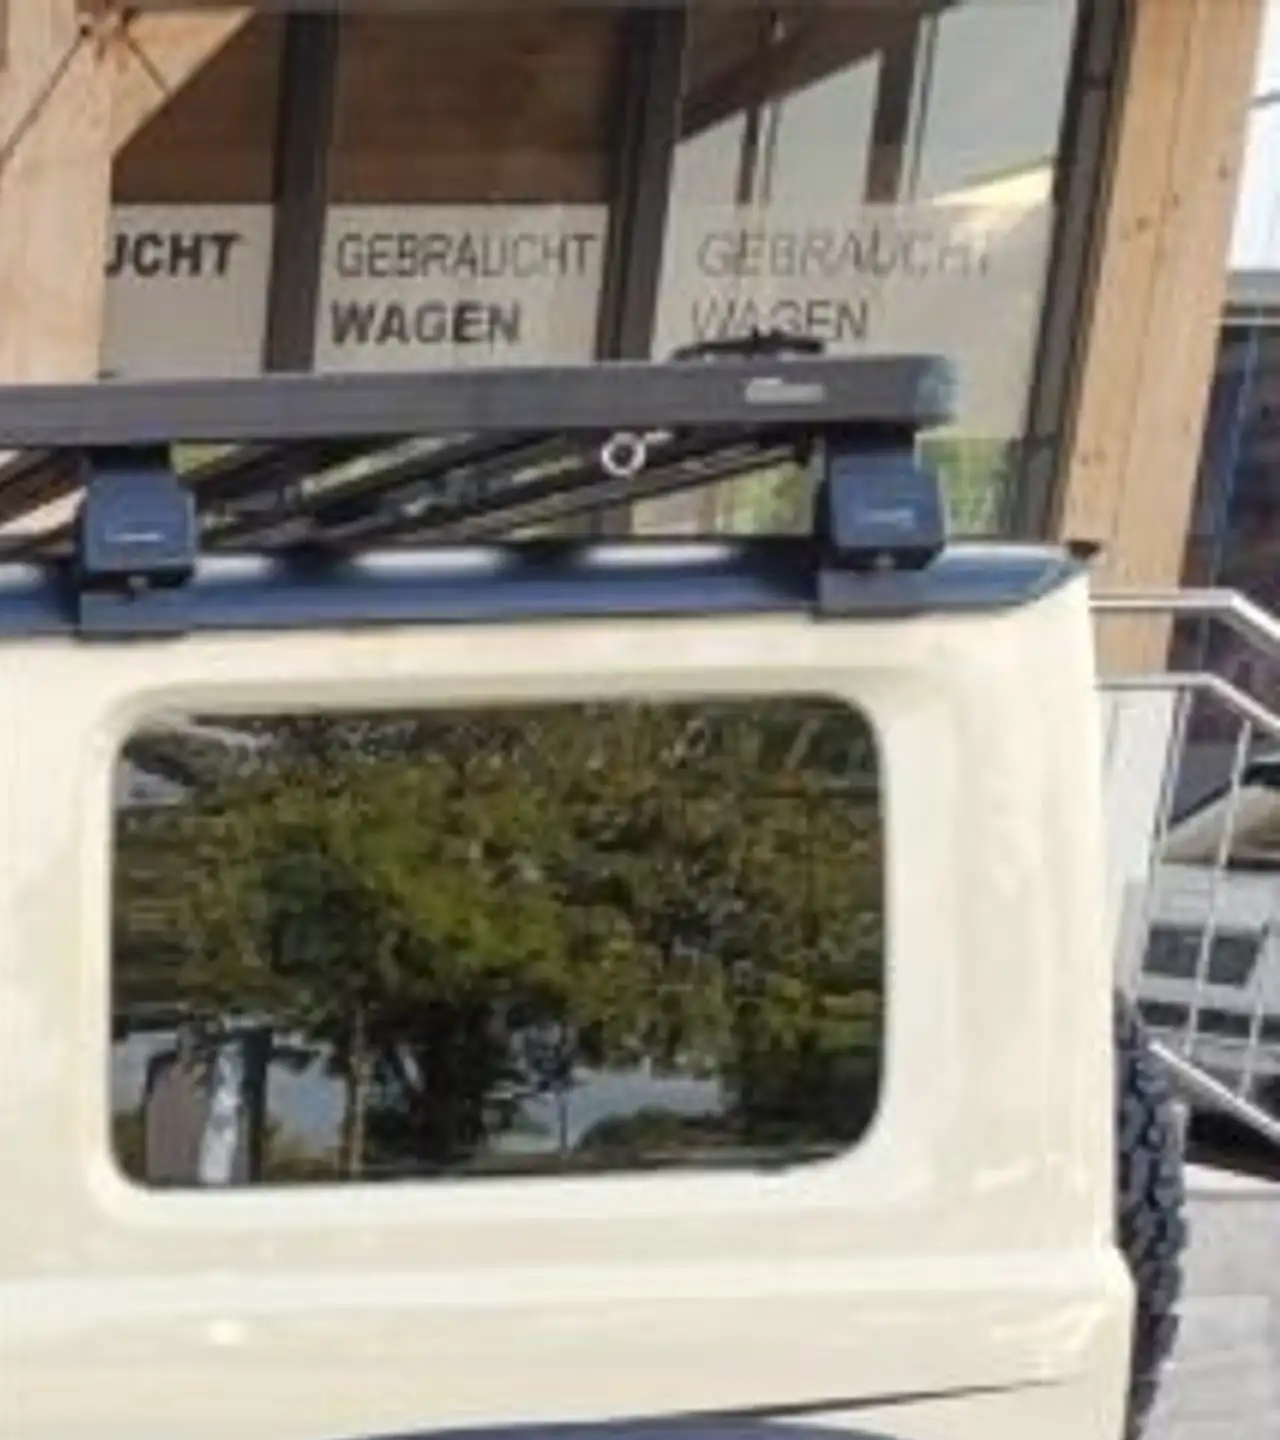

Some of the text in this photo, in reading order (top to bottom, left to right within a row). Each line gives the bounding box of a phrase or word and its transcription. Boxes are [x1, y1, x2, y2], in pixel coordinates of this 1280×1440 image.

[336, 232, 598, 280] GEBRAUCHT
[697, 229, 989, 278] GEBRAUCHT
[331, 299, 521, 346] WAGEN
[692, 298, 868, 340] WAGEN
